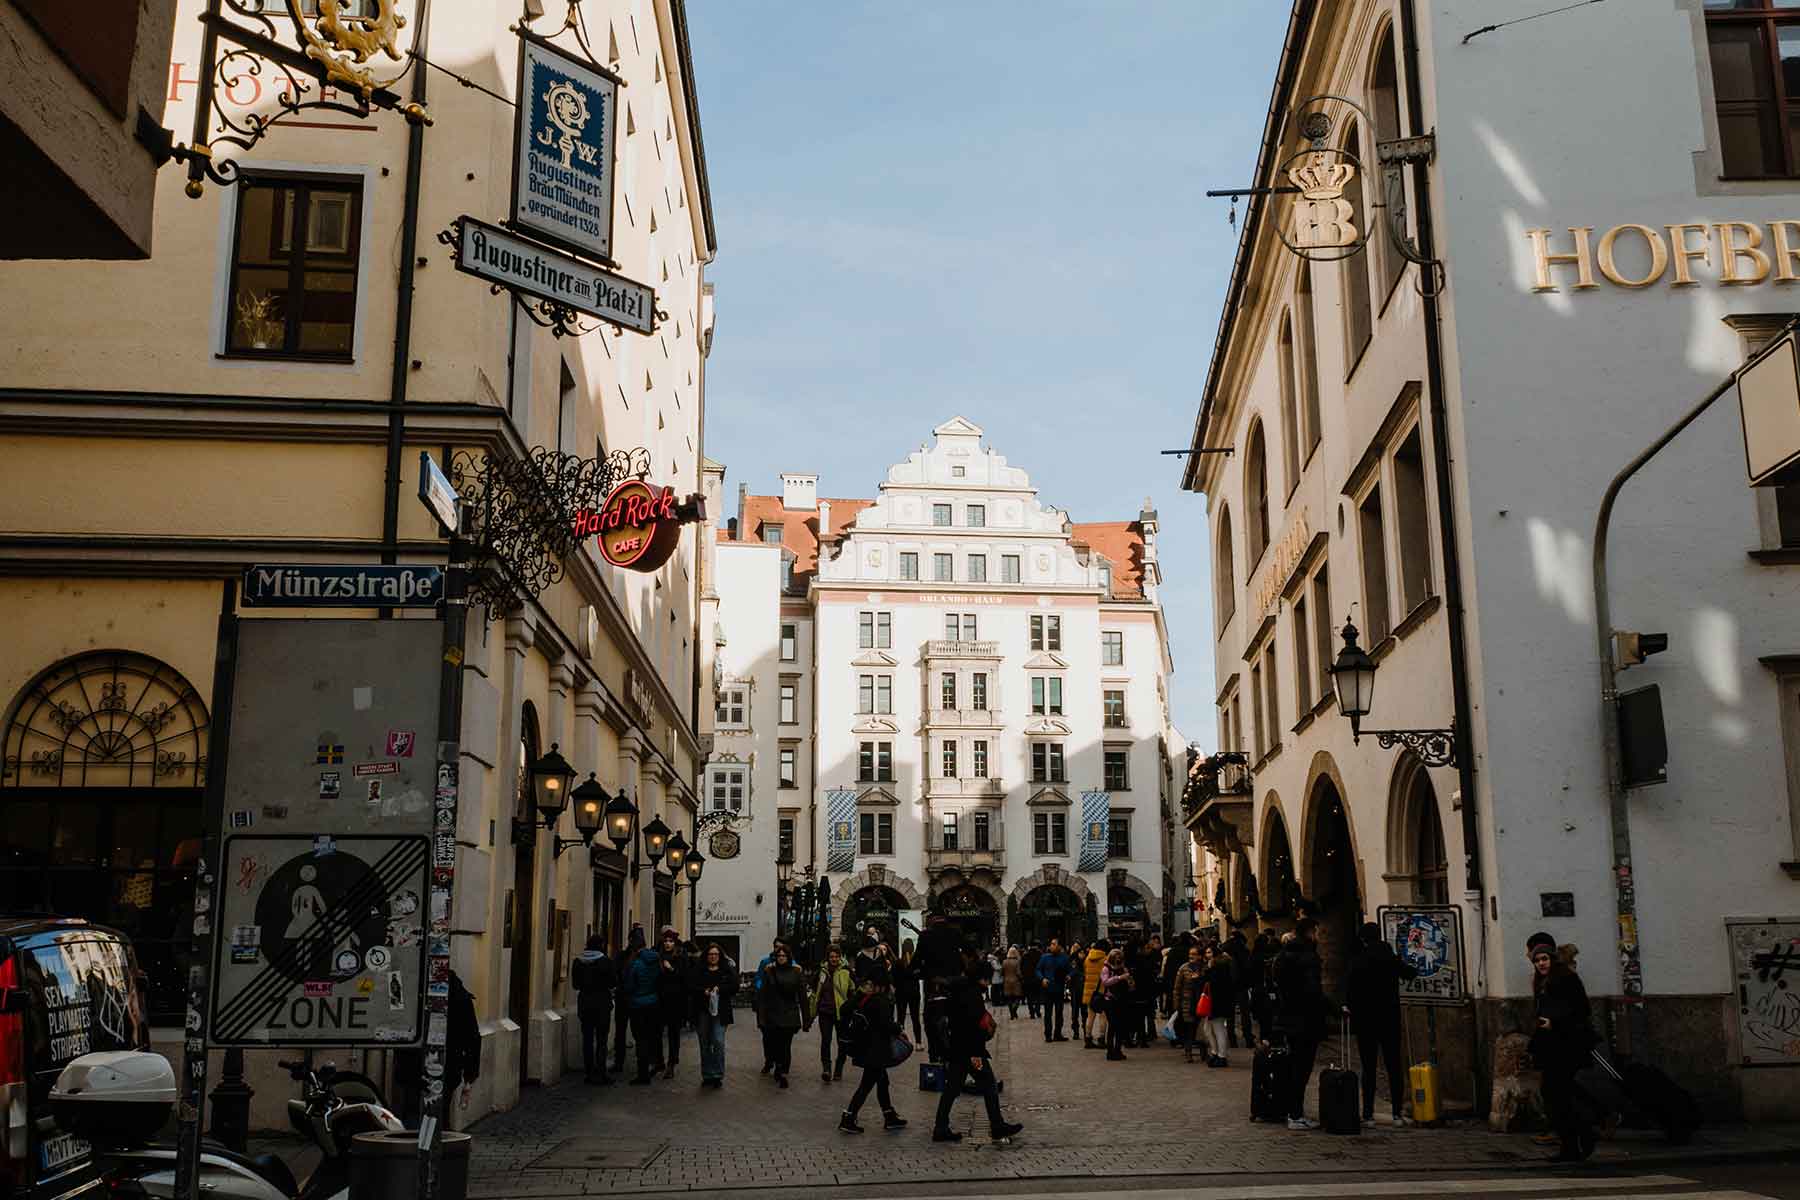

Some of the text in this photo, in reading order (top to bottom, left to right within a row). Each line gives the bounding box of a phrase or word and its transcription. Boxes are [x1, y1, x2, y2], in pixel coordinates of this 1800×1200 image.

[528, 198, 600, 237] gegründet 1328
[472, 230, 574, 294] Augustiner
[574, 277, 592, 298] am
[574, 485, 674, 538] Hard Rock
[612, 537, 641, 555] CAFE
[256, 568, 432, 604] Münzstraße
[48, 1006, 91, 1035] PLAYMATES
[265, 997, 369, 1030] ZONE
[50, 1032, 91, 1063] STRIPPERS
